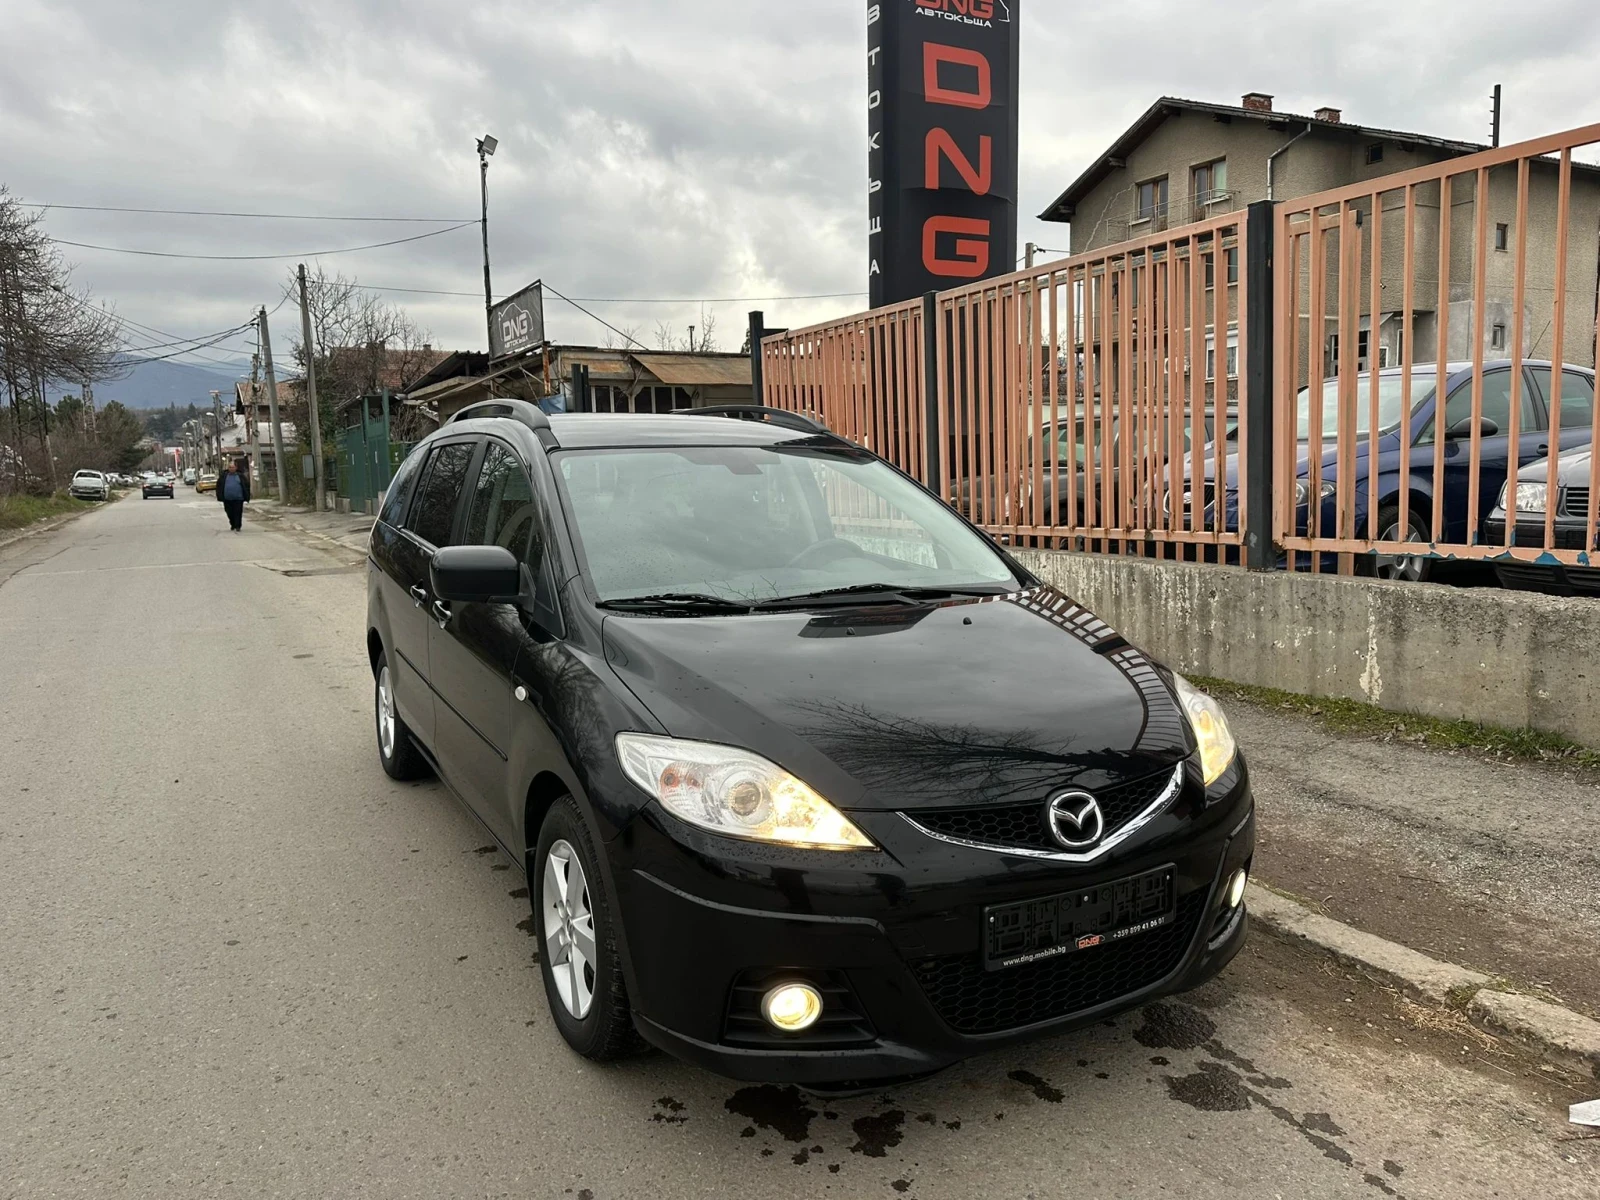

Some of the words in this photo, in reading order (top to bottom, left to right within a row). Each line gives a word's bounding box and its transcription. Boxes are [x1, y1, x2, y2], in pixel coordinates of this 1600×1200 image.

[915, 7, 992, 28] АВТОКЪЩА
[922, 41, 992, 278] DNG
[502, 312, 528, 342] DNG
[1003, 946, 1067, 967] www.dng.mobile.bg
[1078, 936, 1100, 950] DNG
[1113, 928, 1129, 939] +359
[1129, 925, 1141, 934] 899
[1142, 922, 1149, 930] 41
